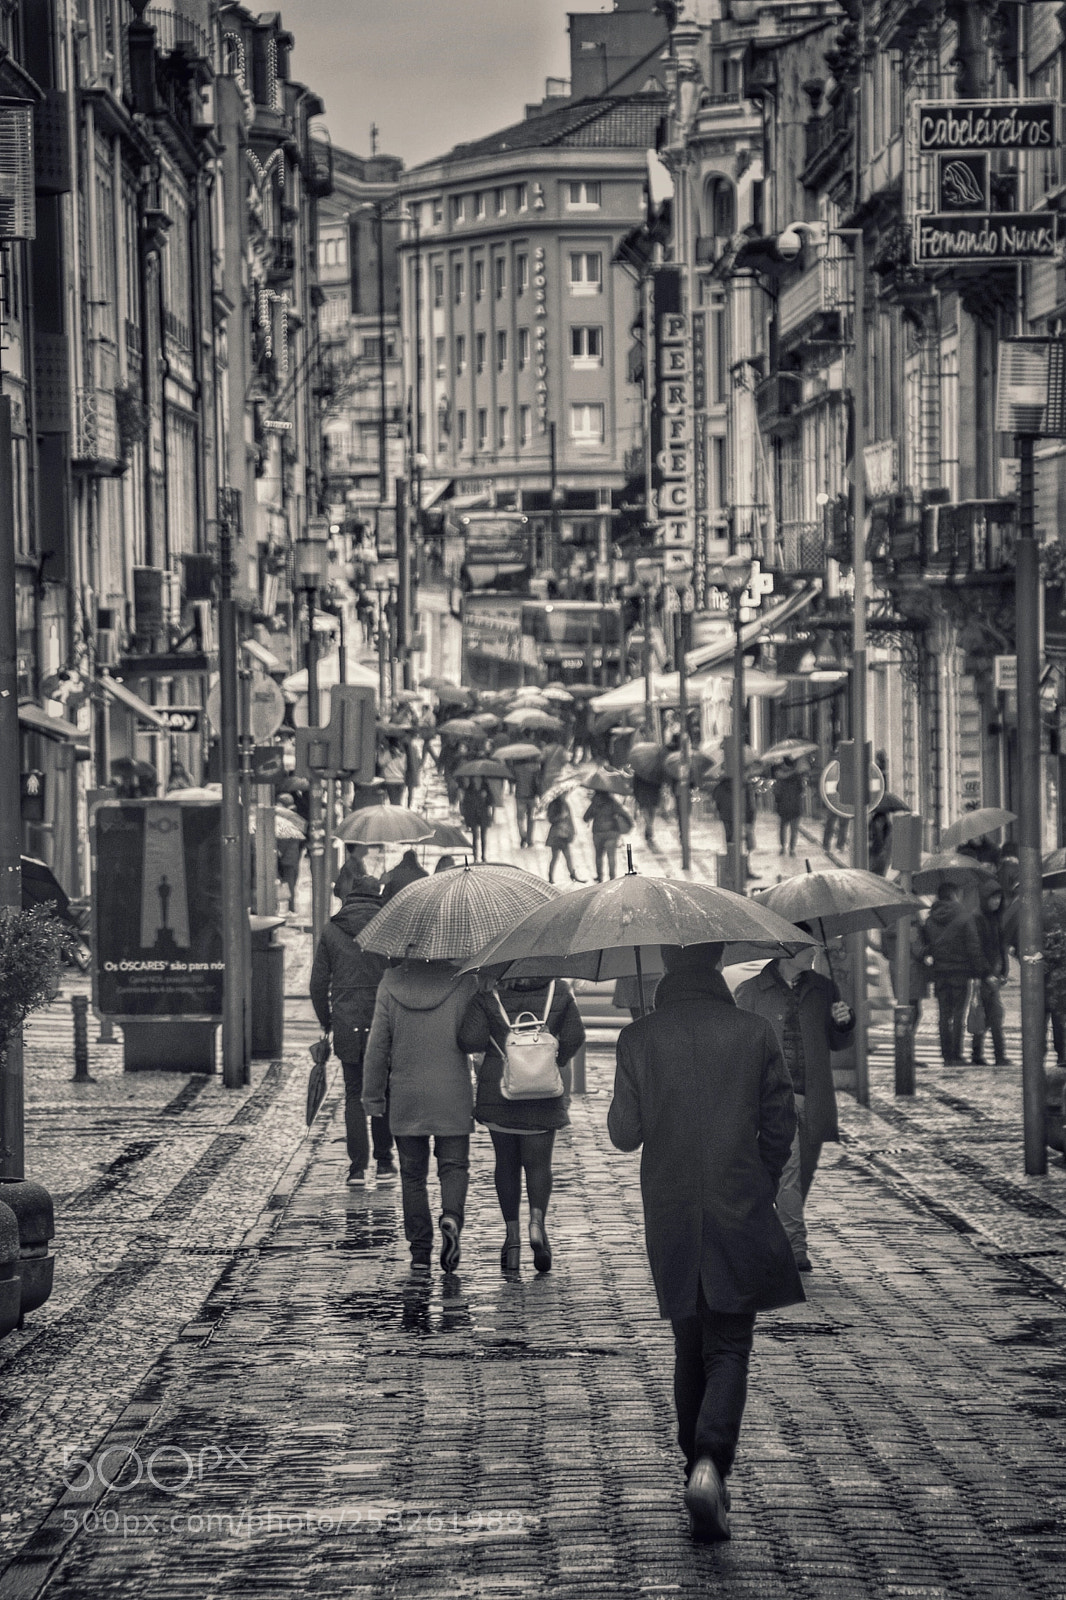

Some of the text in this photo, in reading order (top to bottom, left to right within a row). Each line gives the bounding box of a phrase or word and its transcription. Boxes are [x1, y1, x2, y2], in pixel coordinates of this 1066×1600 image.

[533, 182, 545, 208] LA
[921, 218, 998, 257] Fernando
[534, 246, 546, 315] SPOSA
[103, 961, 118, 971] Os
[188, 963, 209, 973] para
